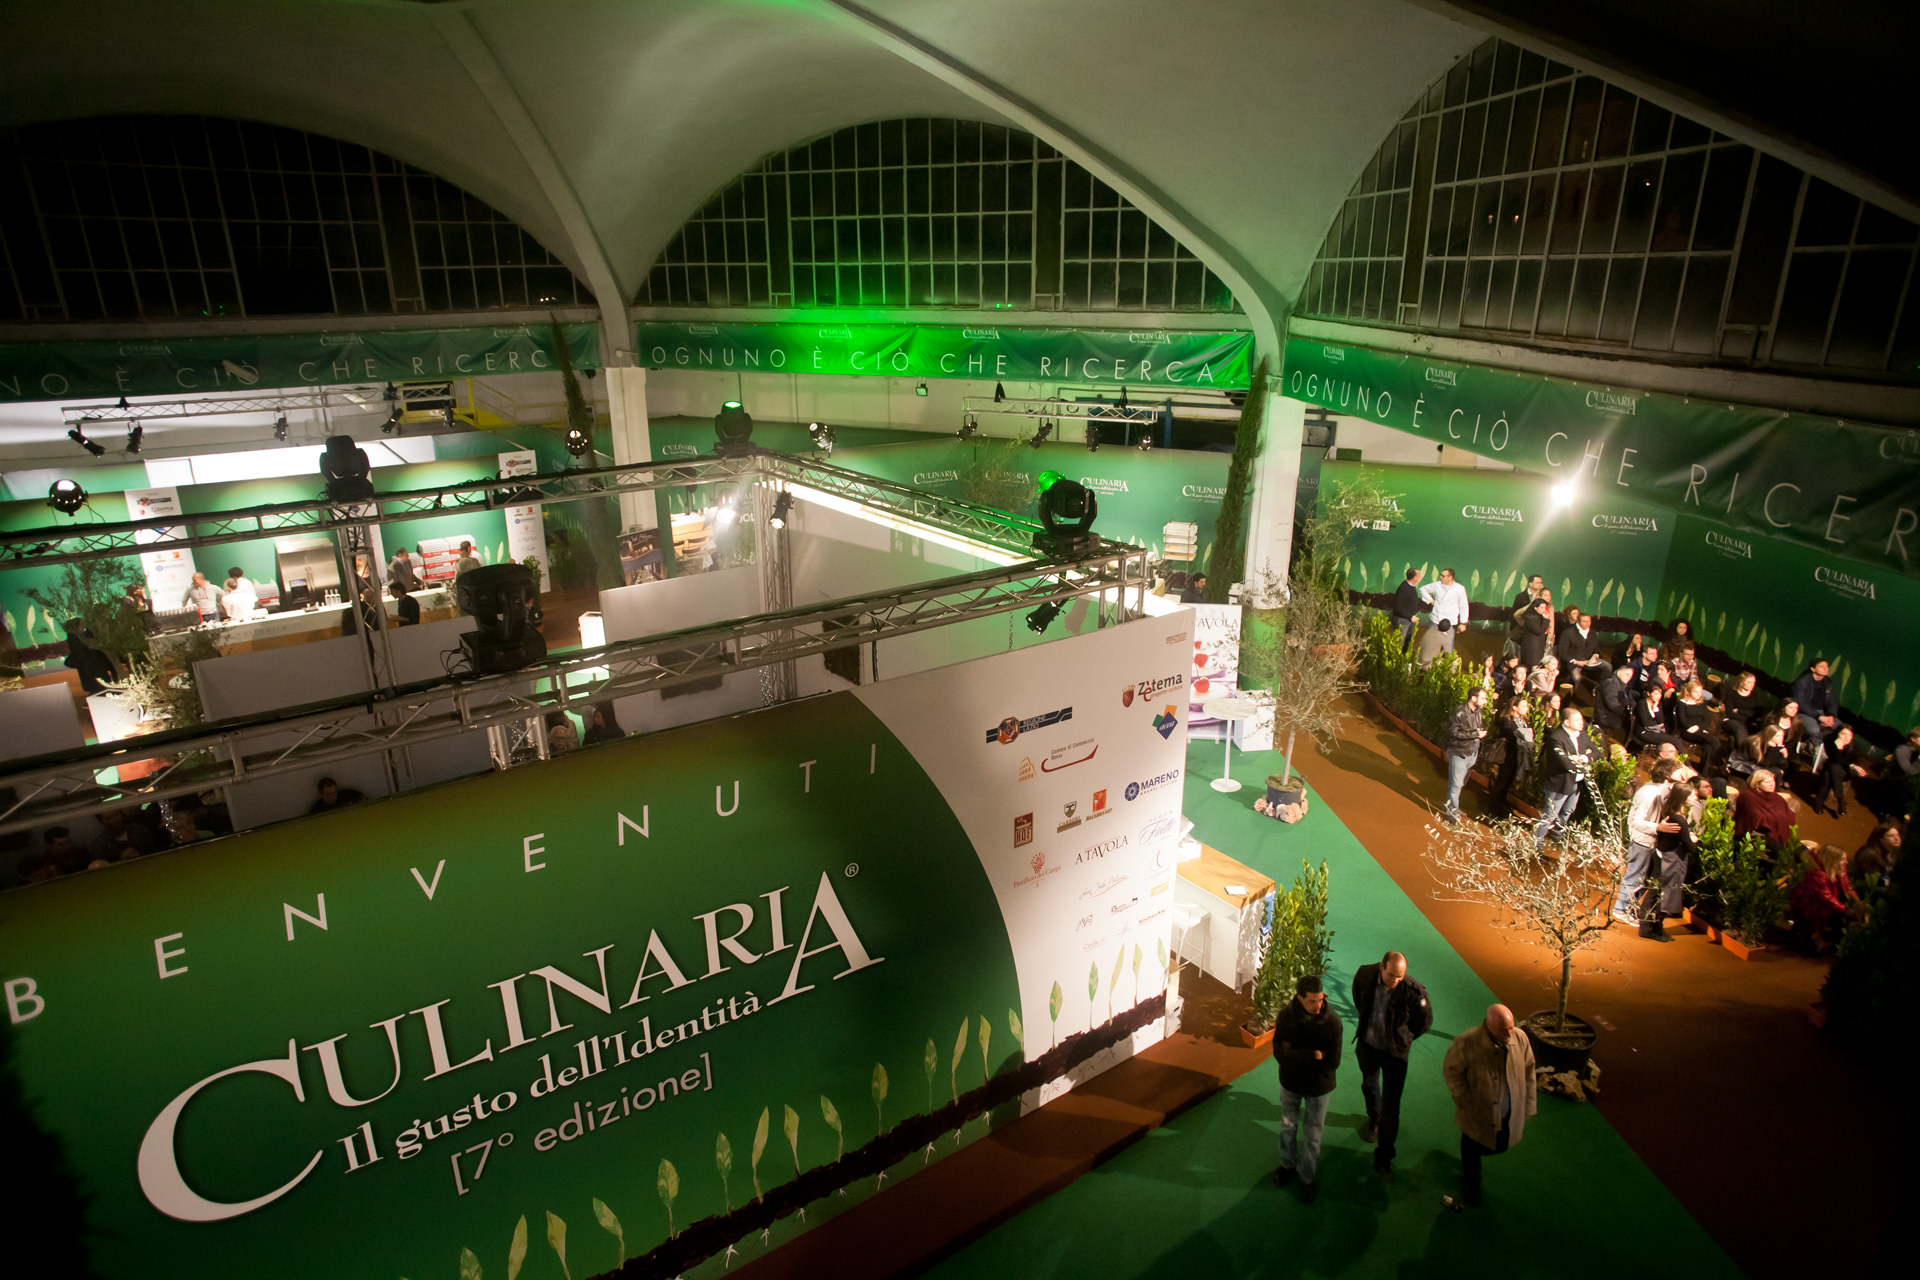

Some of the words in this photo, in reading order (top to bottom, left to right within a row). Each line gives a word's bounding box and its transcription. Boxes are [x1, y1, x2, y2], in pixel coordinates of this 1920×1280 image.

[1129, 332, 1171, 344] CULINARIA
[115, 366, 132, 392] È
[299, 358, 377, 382] CHE
[651, 346, 786, 368] OGNUNO
[813, 346, 822, 369] È
[851, 347, 909, 371] CIÒ
[940, 353, 1007, 375] CHE
[1040, 356, 1214, 383] RICERCA
[1425, 367, 1457, 387] CULINARIA
[1585, 391, 1637, 416] CULINARIA
[1292, 370, 1393, 418] OGNUNO
[1413, 392, 1425, 428] È
[1448, 408, 1509, 451] CIÒ
[1545, 431, 1639, 487] CHE
[913, 470, 959, 485] CULINARIA
[1080, 477, 1129, 492] CULINARIA
[1351, 519, 1369, 529] WC
[1462, 504, 1524, 522] CULINARIA
[1591, 514, 1658, 531] CULINARIA
[1705, 530, 1752, 559] CULINARIA
[1814, 566, 1876, 600] CULINARIA
[1137, 674, 1183, 703] Zètema
[1140, 769, 1180, 791] MARENO
[1075, 853, 1083, 865] A
[1085, 835, 1129, 860] TAVOLA
[3, 743, 877, 1025] BENVENUTI
[336, 1120, 384, 1175] Il
[394, 1090, 518, 1160] gusto
[529, 990, 763, 1099] dell'Identità
[450, 1131, 515, 1197] [7°
[533, 1052, 714, 1152] edizione]
